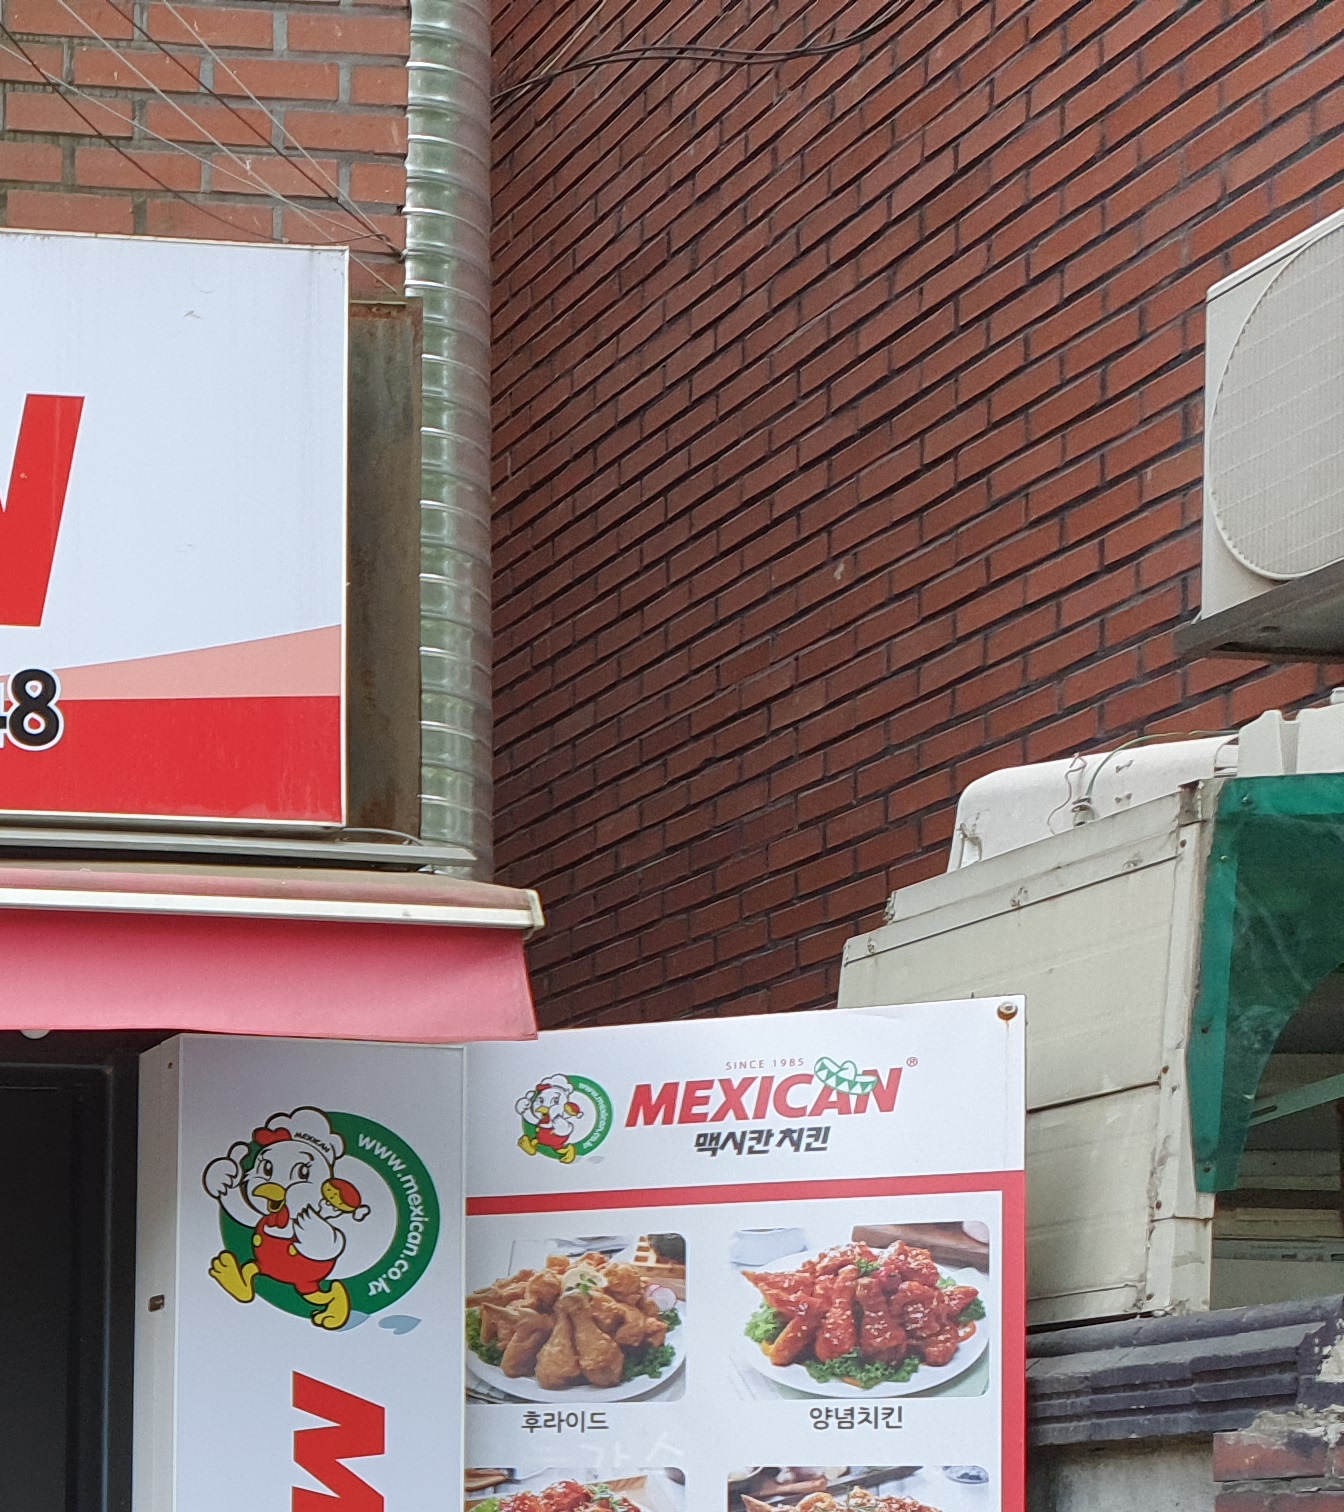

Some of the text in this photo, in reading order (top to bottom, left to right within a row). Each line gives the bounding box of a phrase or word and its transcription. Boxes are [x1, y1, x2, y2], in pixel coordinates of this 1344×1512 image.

[725, 1057, 806, 1071] SINCE 1985
[624, 1066, 904, 1128] MEXICAN
[357, 1132, 429, 1297] www.mexican.co.kr
[520, 1410, 610, 1435] 후라이드
[809, 1406, 904, 1431] 양념치킨
